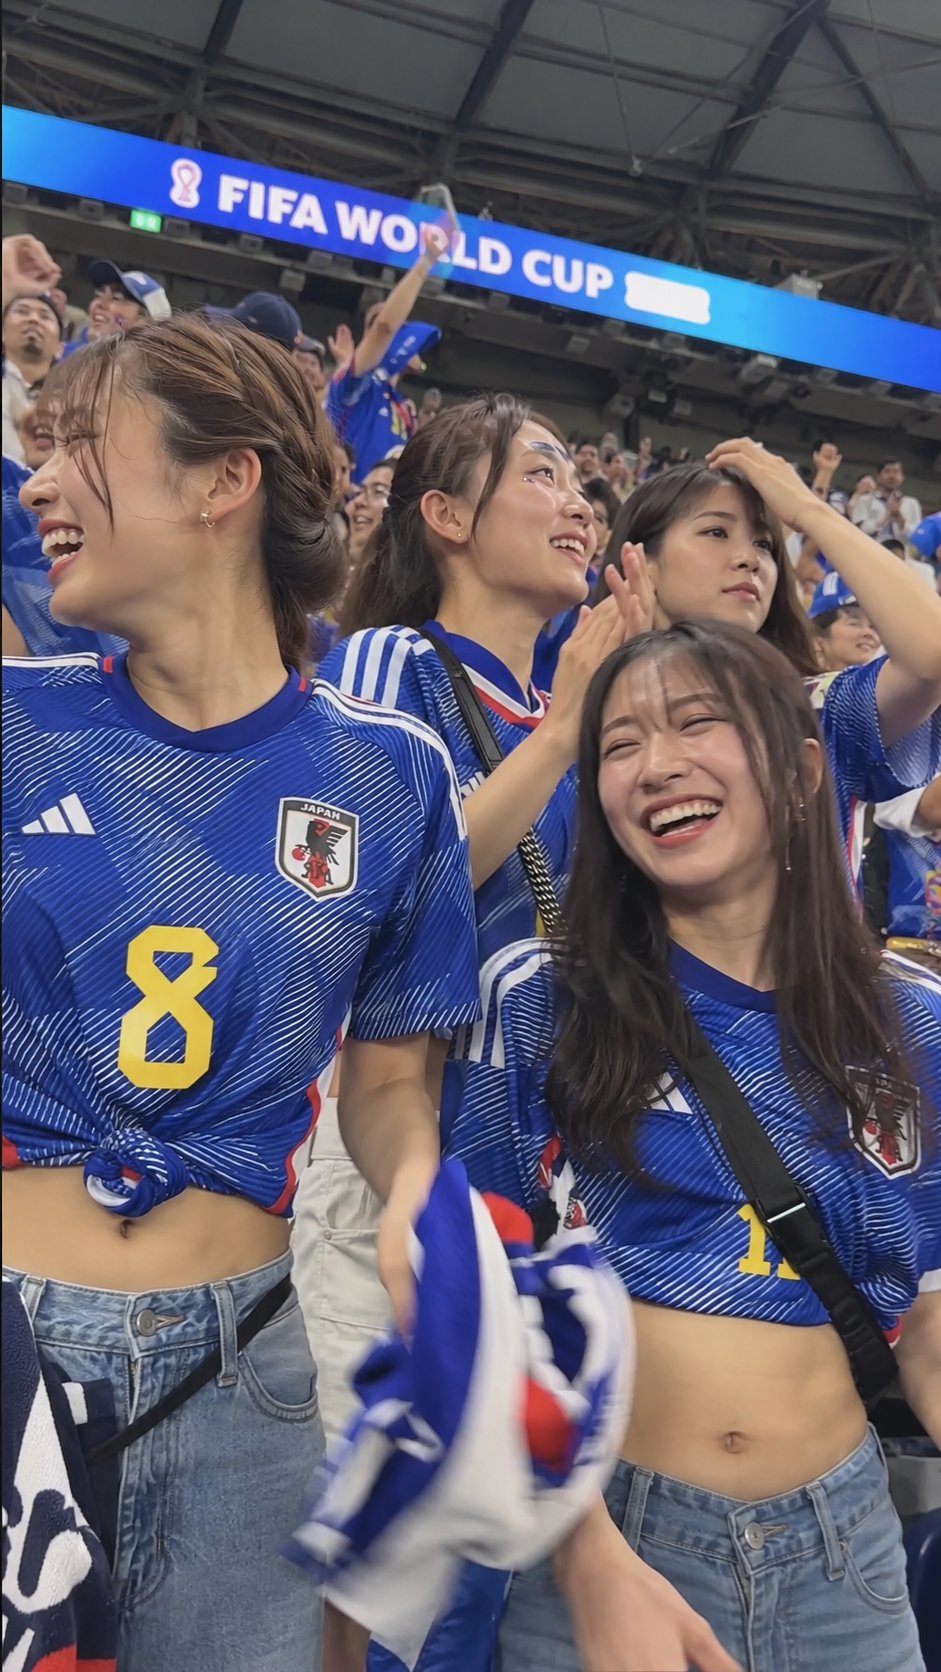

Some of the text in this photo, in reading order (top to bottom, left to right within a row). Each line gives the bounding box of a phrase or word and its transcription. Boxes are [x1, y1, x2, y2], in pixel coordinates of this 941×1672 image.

[217, 173, 328, 235] FIFA
[522, 249, 614, 298] CUP
[301, 803, 341, 820] JAPAN
[117, 924, 220, 1089] 8
[737, 1203, 801, 1280] 1
